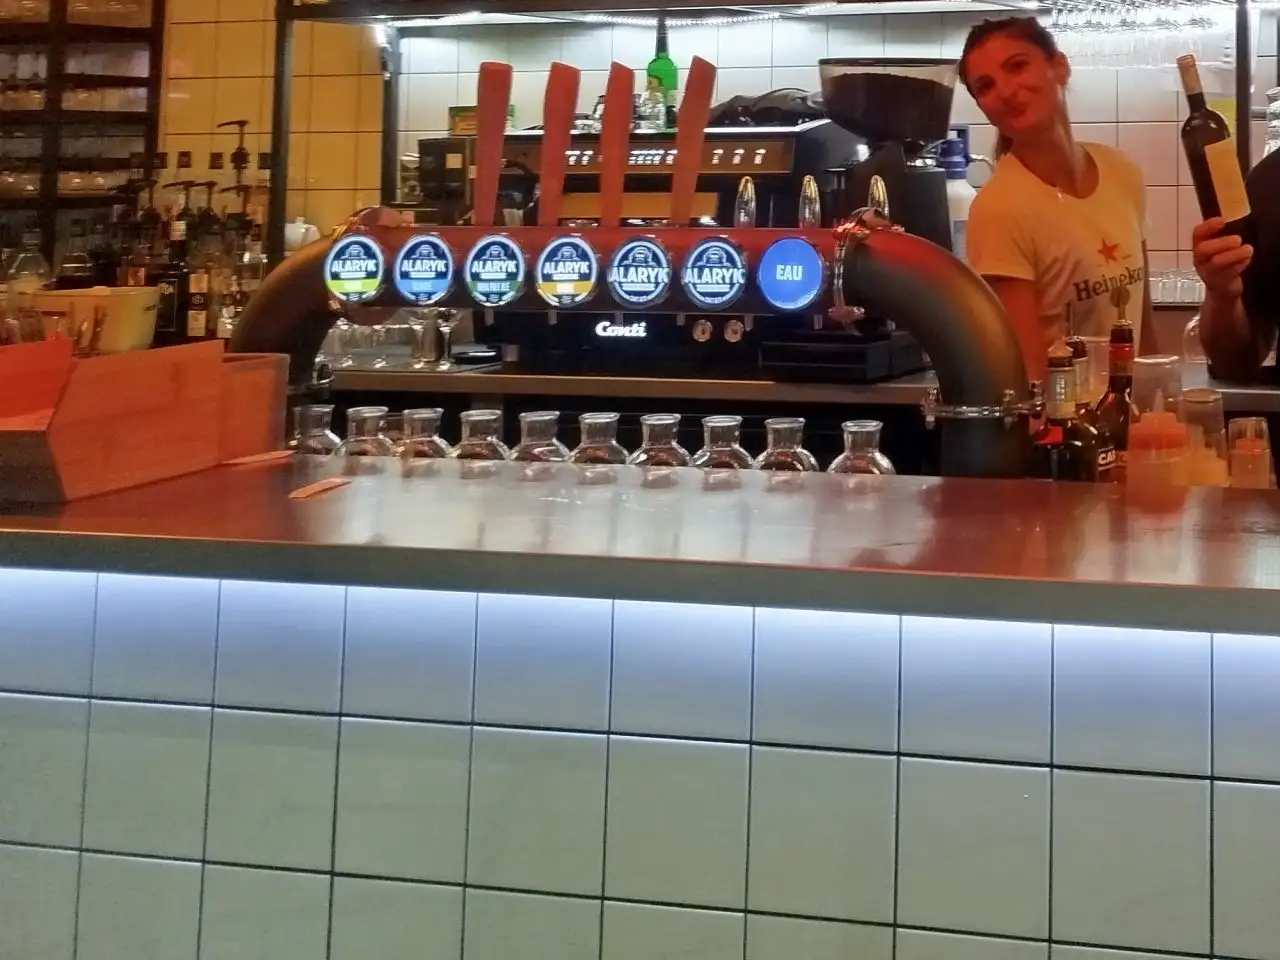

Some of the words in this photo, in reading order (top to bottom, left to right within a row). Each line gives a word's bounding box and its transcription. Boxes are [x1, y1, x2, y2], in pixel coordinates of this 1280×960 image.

[331, 259, 377, 273] ALARYK
[401, 259, 448, 273] ALARYK
[471, 260, 517, 273] ALARYK
[543, 261, 590, 274] ALARYK
[776, 264, 803, 281] EAU
[609, 266, 670, 283] ALARYK
[685, 267, 746, 284] ALARYK
[595, 321, 647, 338] Conti
